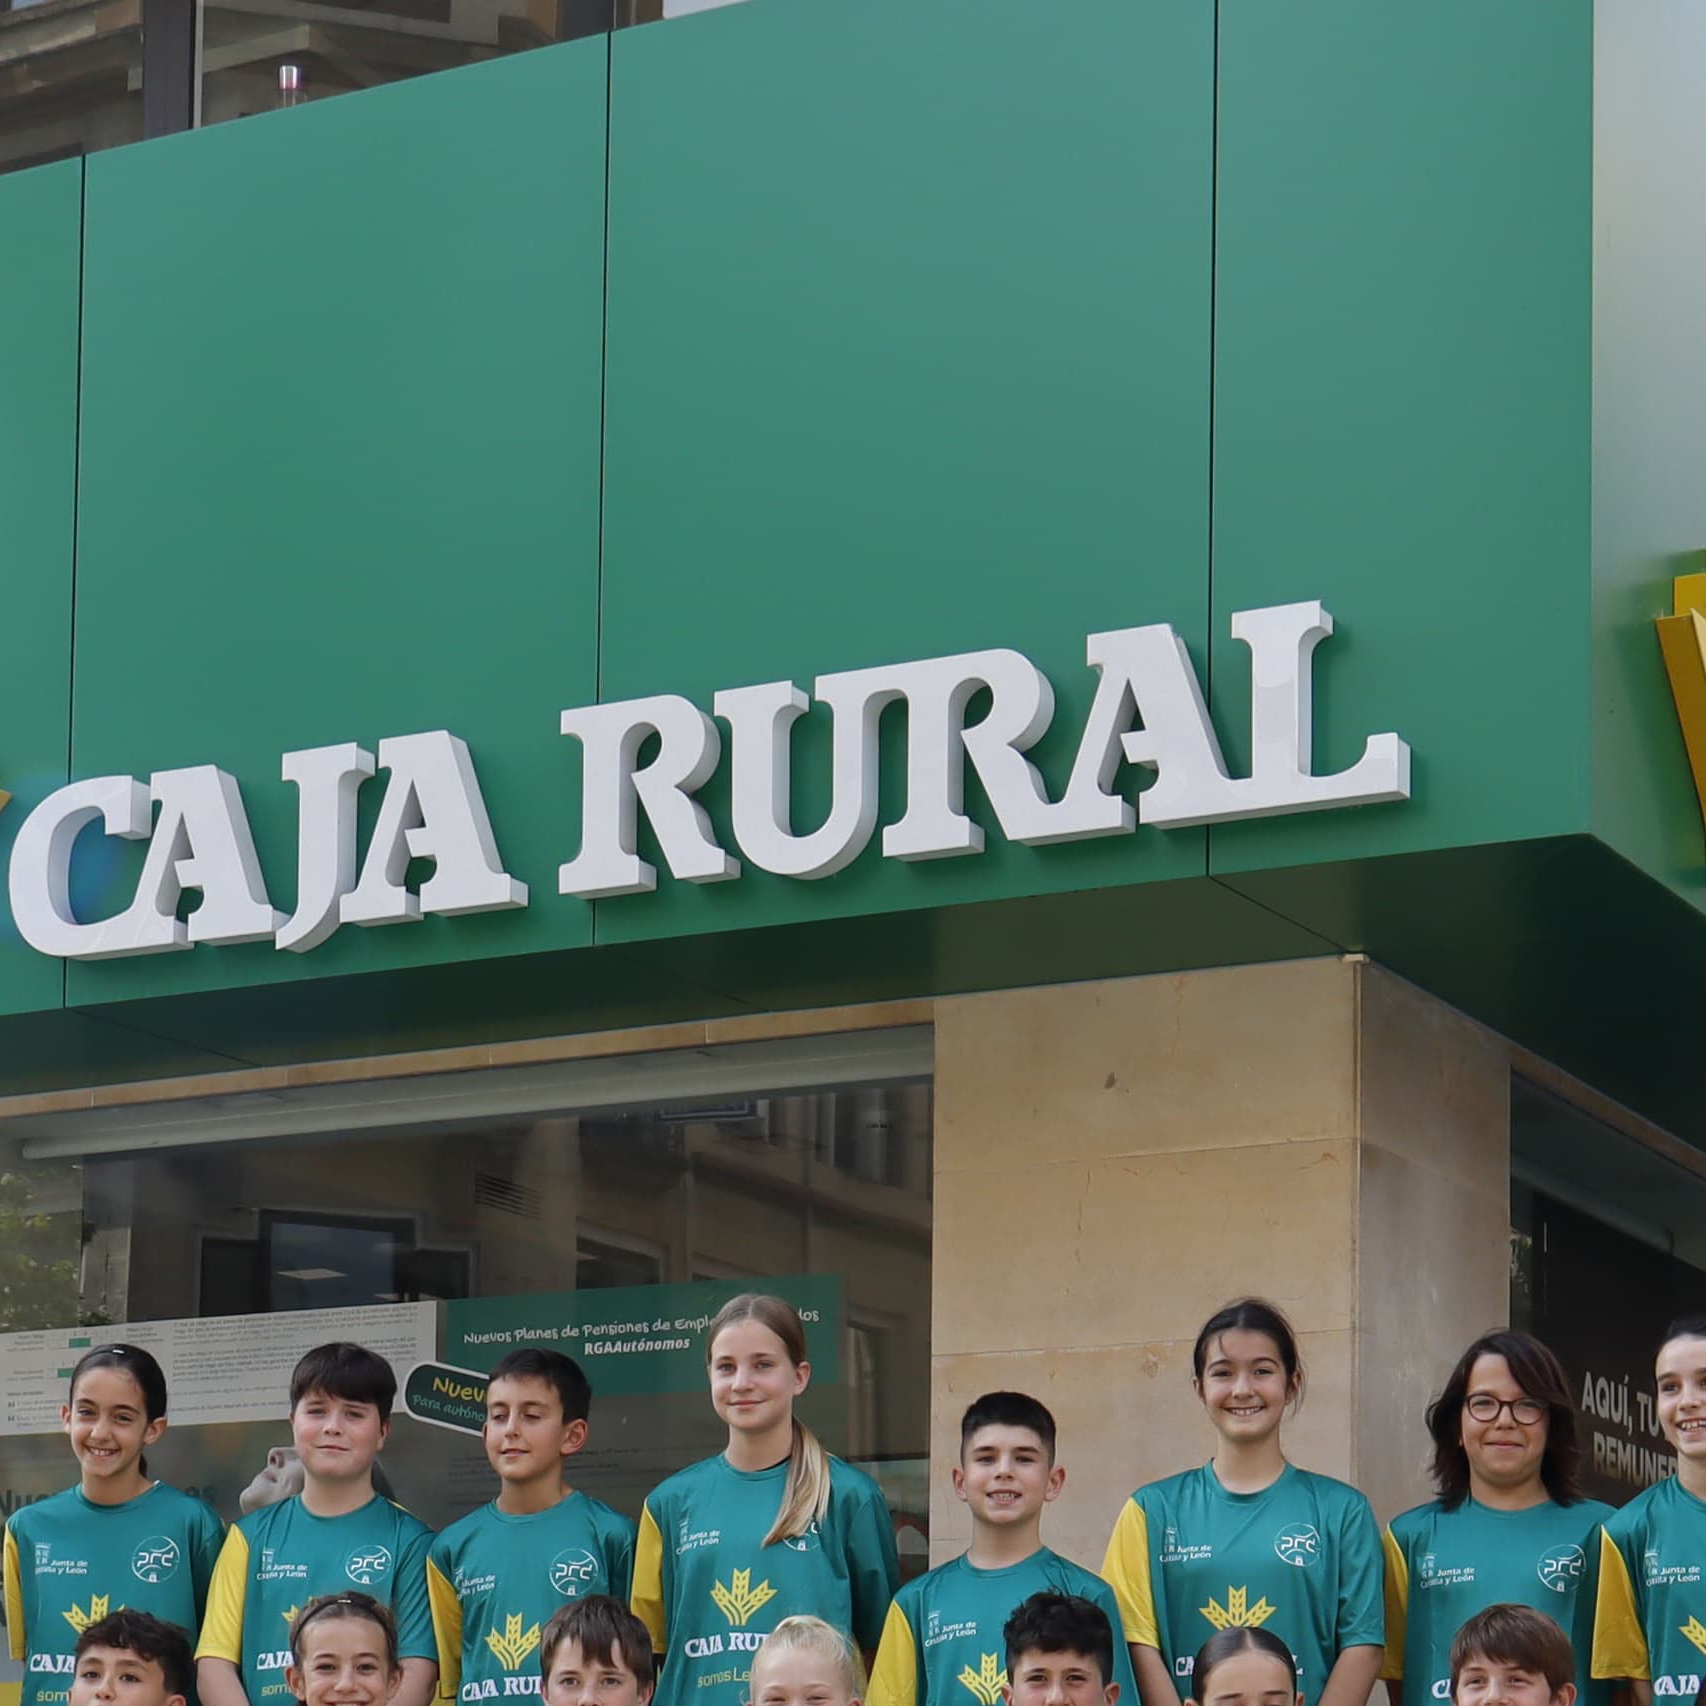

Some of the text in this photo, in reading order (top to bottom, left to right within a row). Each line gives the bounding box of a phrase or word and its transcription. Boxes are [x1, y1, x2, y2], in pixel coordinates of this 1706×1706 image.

[8, 600, 1411, 960] CAJA RURAL
[463, 1328, 512, 1345] Nuevos
[514, 1326, 558, 1343] Planes
[561, 1323, 579, 1338] de
[583, 1319, 650, 1338] Pensiones
[653, 1317, 671, 1331] de
[584, 1336, 691, 1356] RGAAutónomos
[433, 1377, 485, 1402] Nuev
[444, 1404, 485, 1422] autóno
[685, 1634, 724, 1658] CAJA
